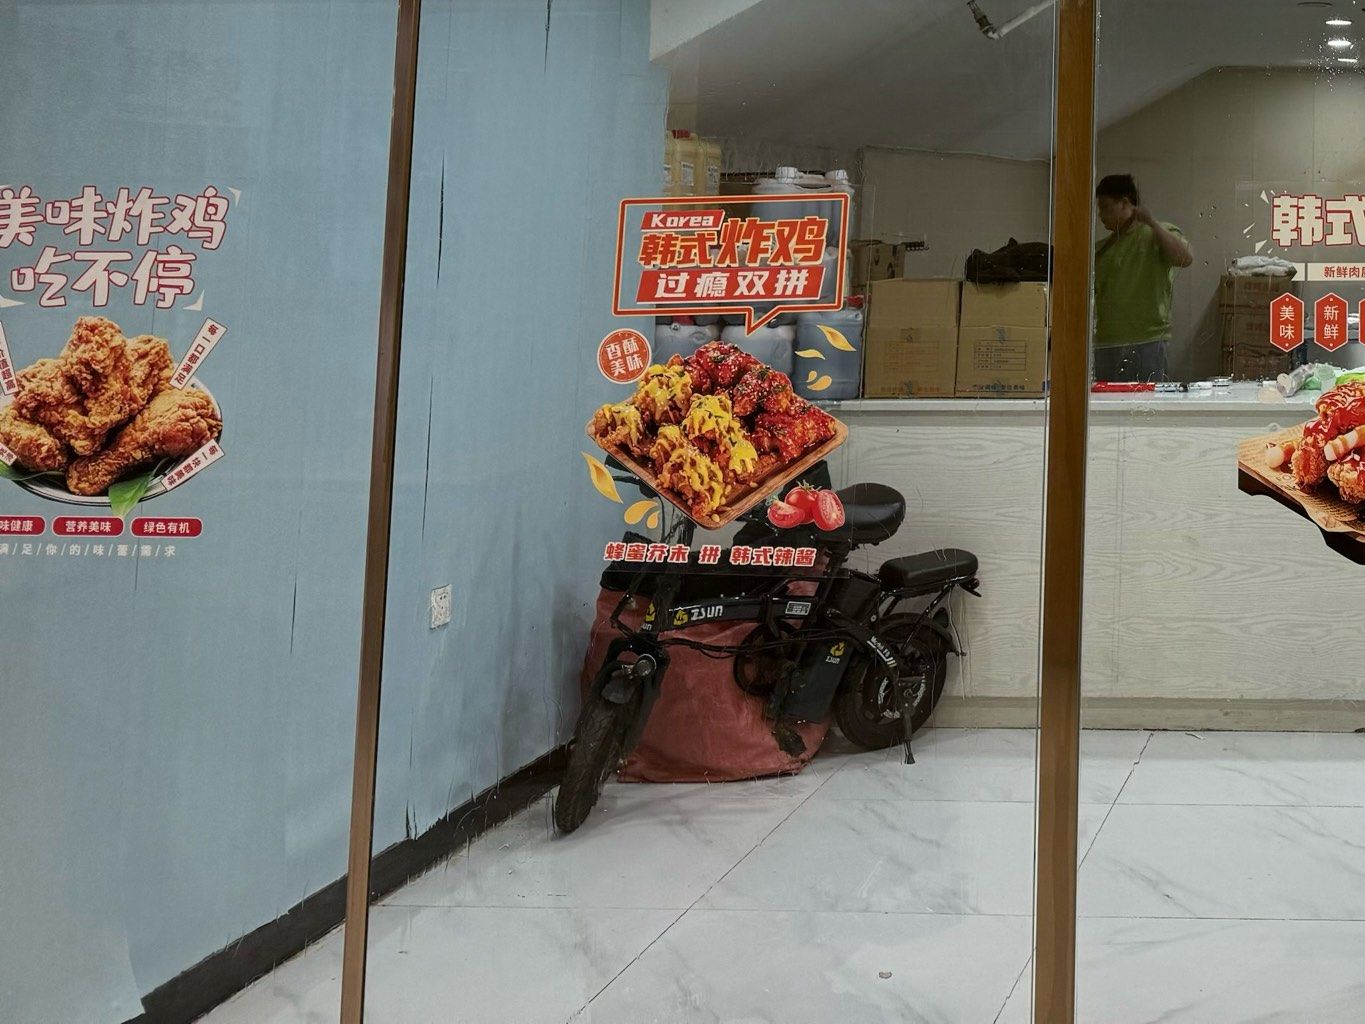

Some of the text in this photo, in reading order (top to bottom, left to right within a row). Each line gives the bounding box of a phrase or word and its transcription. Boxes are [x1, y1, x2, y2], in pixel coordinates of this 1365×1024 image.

[0, 185, 229, 250] 美味炸鸡
[651, 213, 715, 227] Korea
[638, 216, 829, 267] 韩式炸鸡
[11, 244, 197, 309] 吃不停
[655, 269, 809, 298] 过瘾双拼
[1279, 305, 1295, 339] 美味
[1323, 305, 1339, 339] 新鲜
[609, 353, 644, 376] 美味
[65, 520, 112, 533] 营养美味
[143, 521, 190, 534] 绿色有机
[604, 542, 817, 567] 蜂蜜芥末 拼 韩式辣酱
